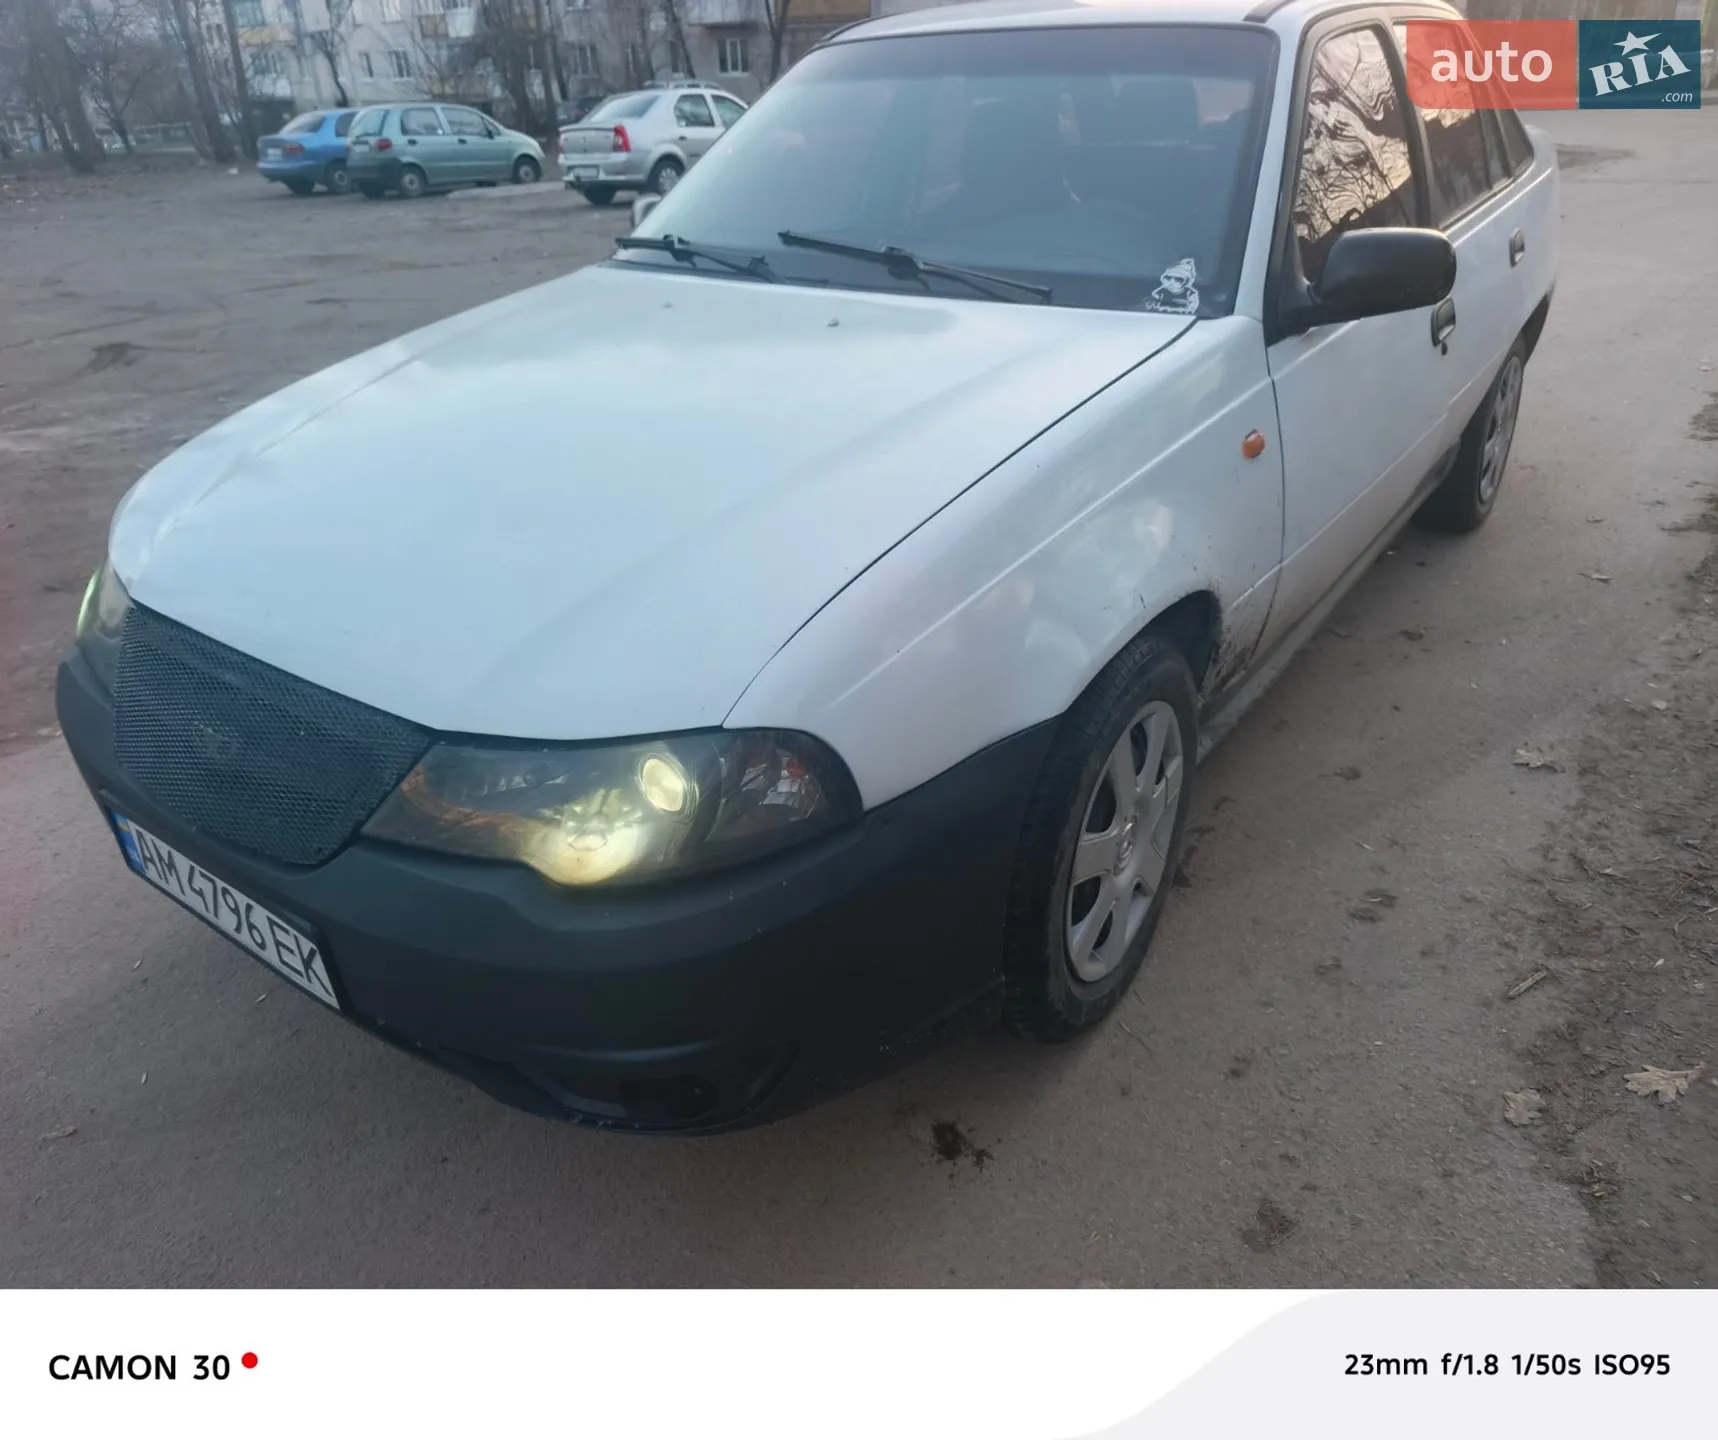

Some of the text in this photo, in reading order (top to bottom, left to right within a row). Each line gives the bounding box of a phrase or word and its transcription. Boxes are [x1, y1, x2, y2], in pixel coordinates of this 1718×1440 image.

[135, 828, 335, 998] AM 4796 EK
